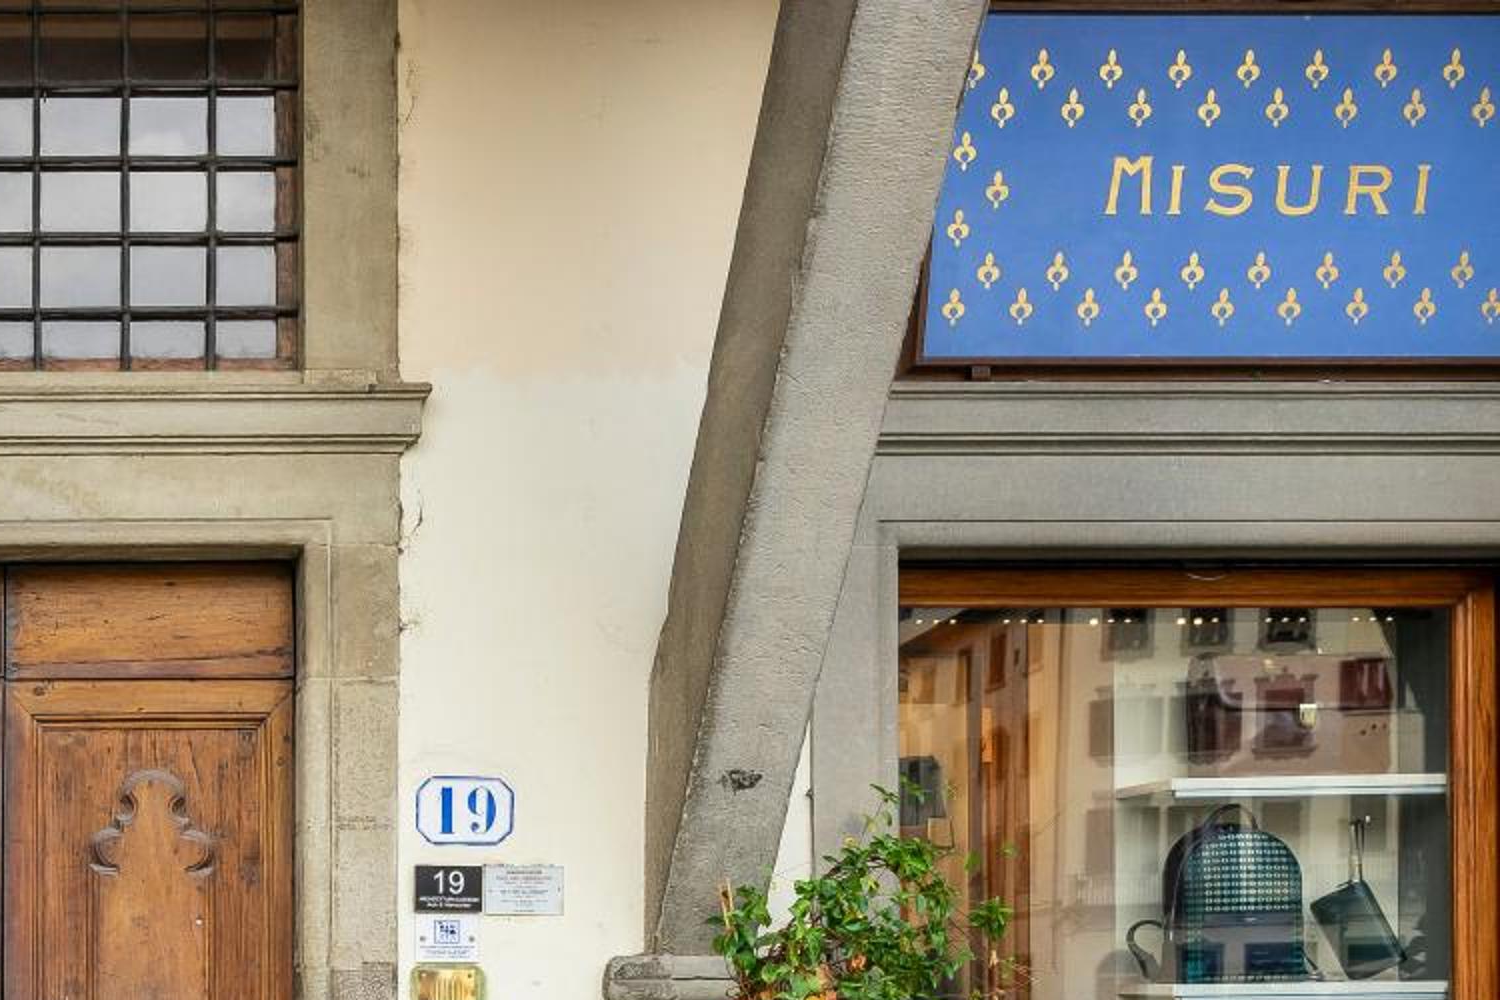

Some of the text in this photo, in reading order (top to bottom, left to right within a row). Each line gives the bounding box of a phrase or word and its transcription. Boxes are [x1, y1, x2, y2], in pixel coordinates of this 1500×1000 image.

[1104, 155, 1432, 216] MISURI
[438, 786, 497, 834] 19
[433, 870, 465, 895] 19
